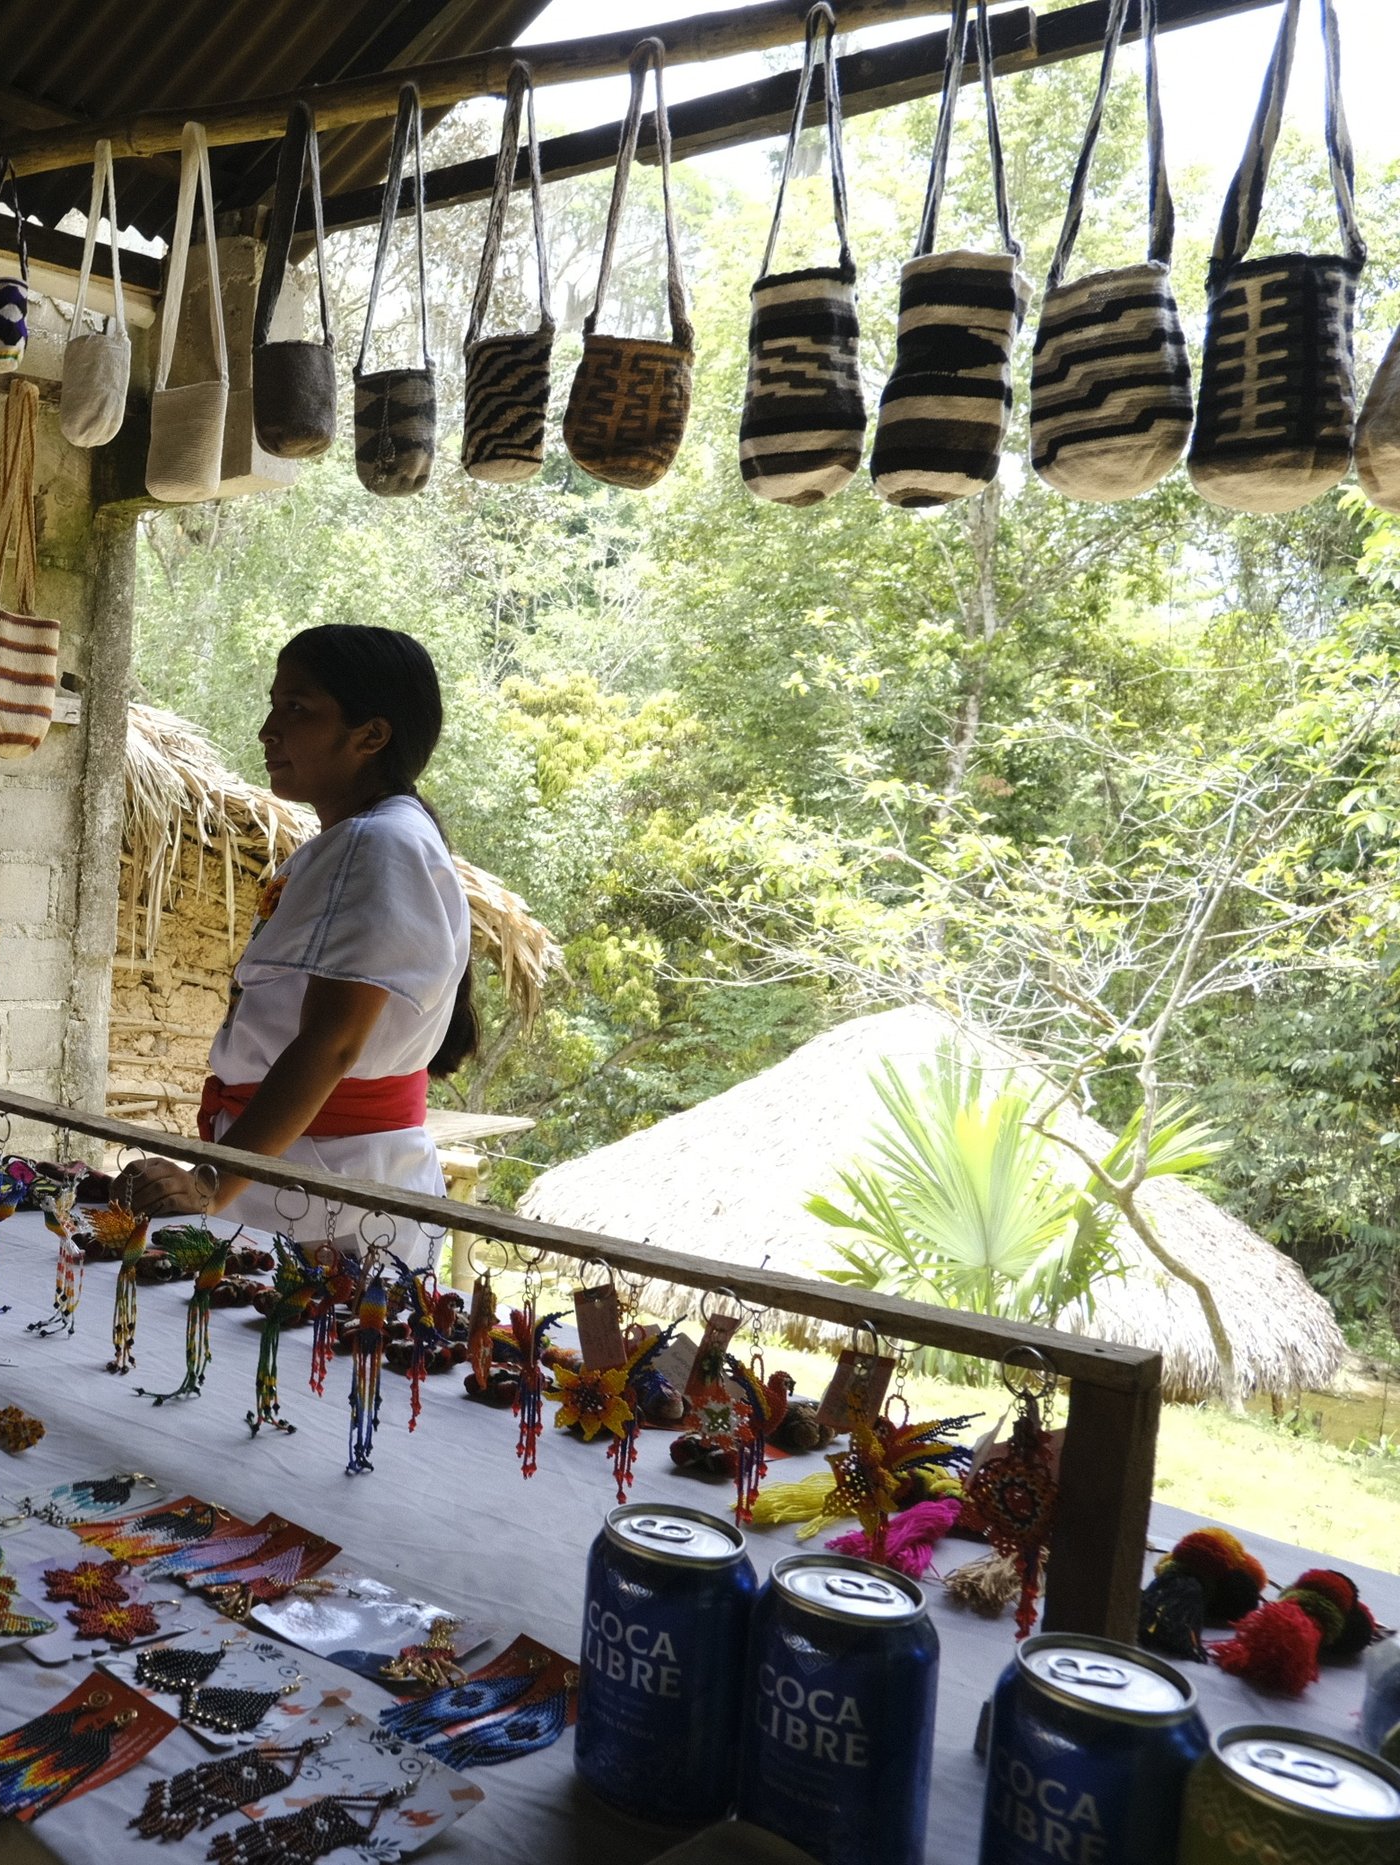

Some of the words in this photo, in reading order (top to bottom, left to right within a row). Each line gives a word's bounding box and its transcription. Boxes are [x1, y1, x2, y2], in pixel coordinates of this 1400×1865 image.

[585, 1630, 682, 1698] LIBRE
[588, 1601, 677, 1662] COCA
[760, 1664, 864, 1729] COCA
